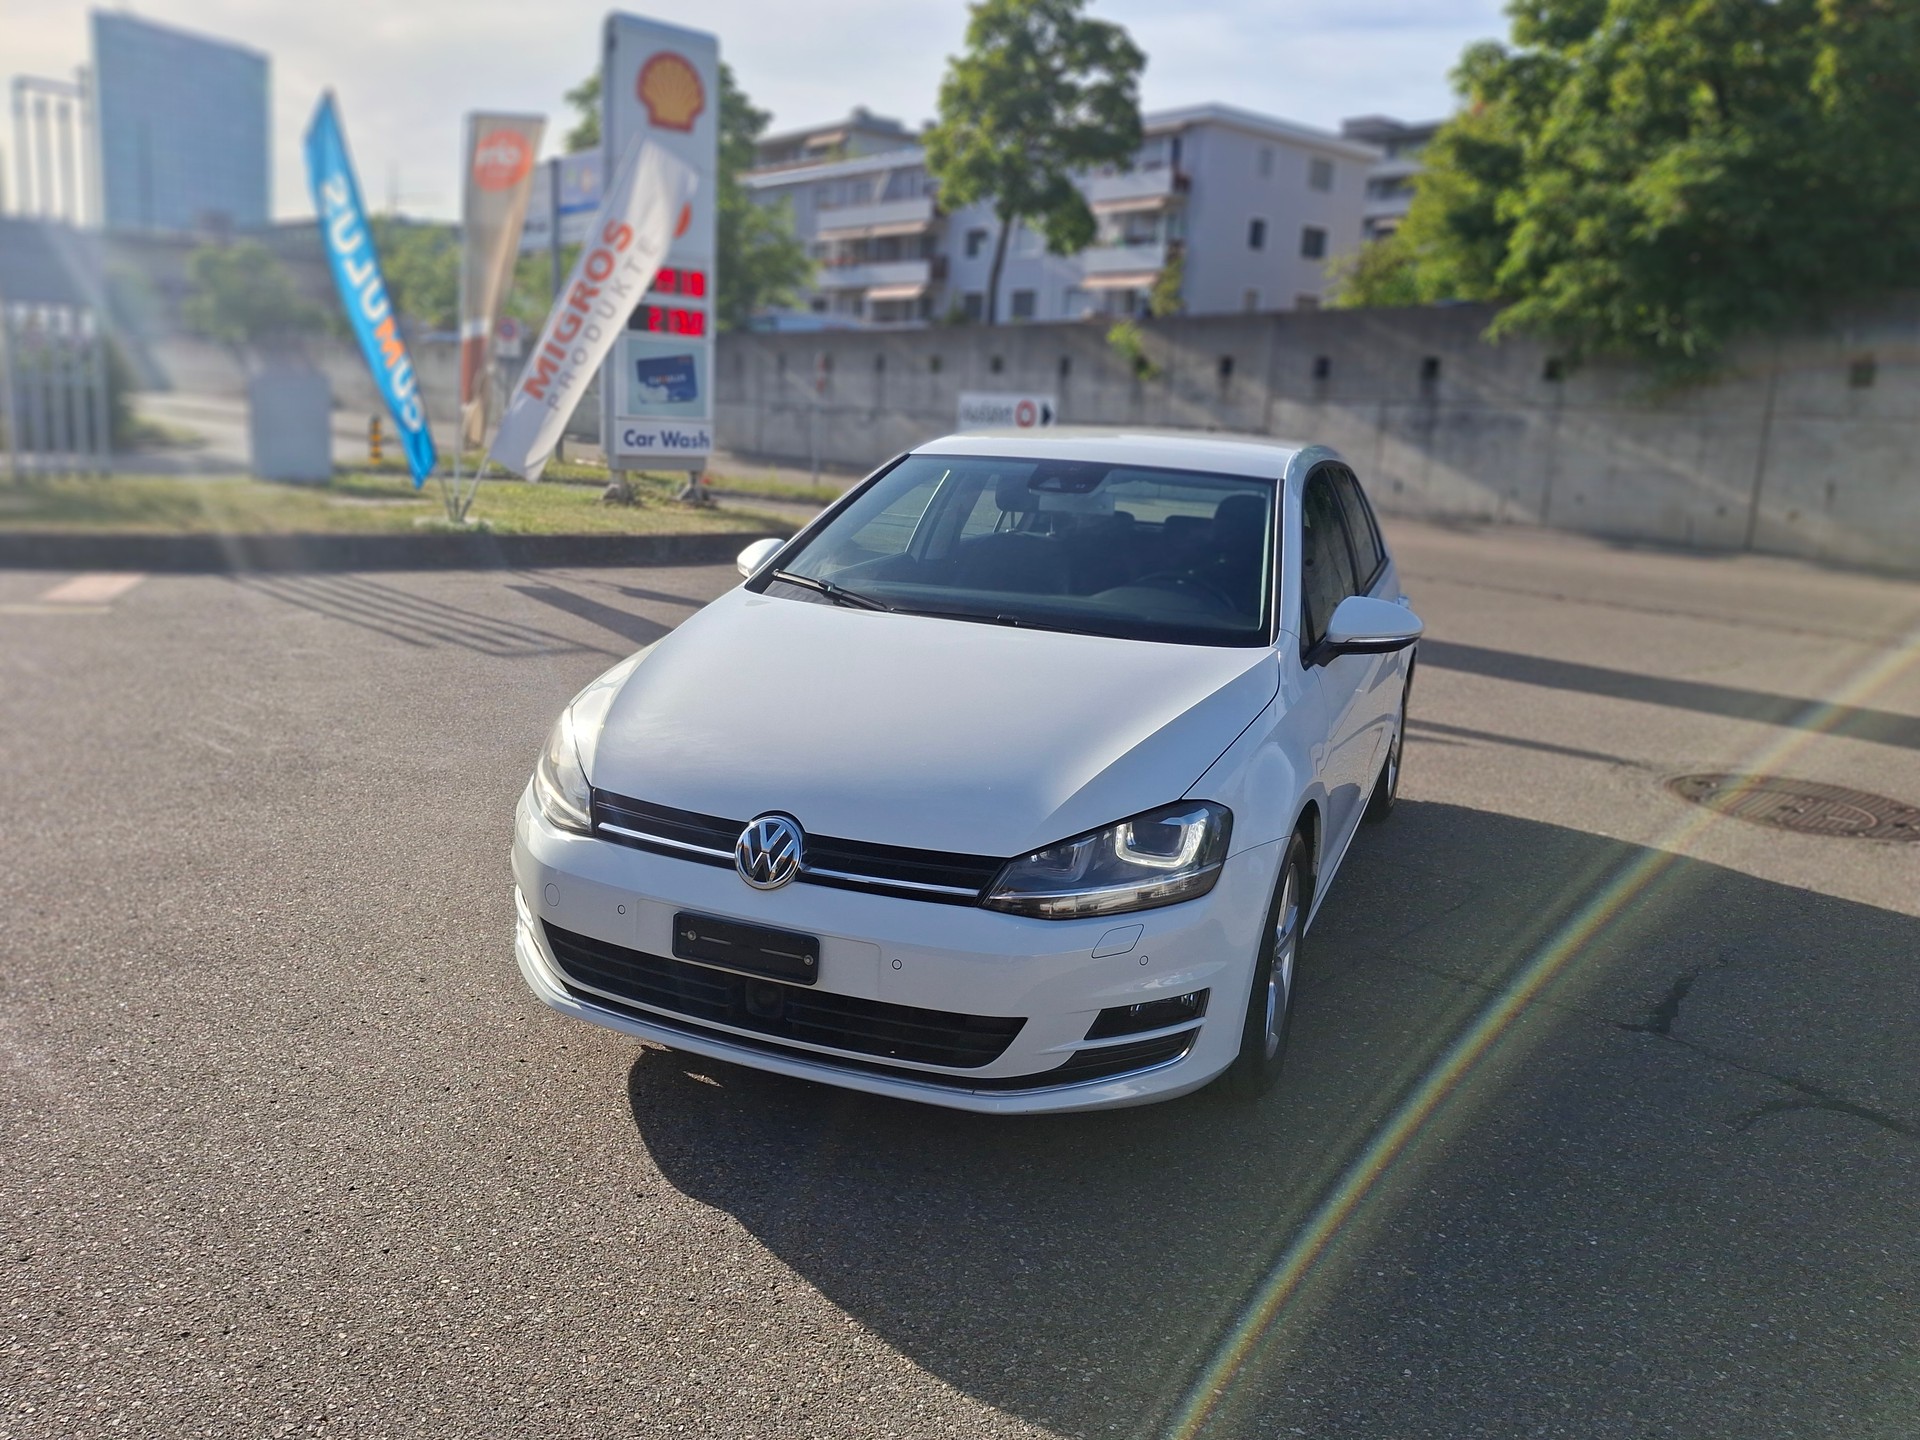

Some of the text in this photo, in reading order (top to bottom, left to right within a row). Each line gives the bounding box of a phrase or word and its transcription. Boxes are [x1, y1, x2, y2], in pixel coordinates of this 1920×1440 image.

[523, 218, 634, 401] MIGROS
[546, 232, 661, 413] PRODUKTE
[623, 429, 711, 450] Car Wash
[737, 818, 800, 887] VW
